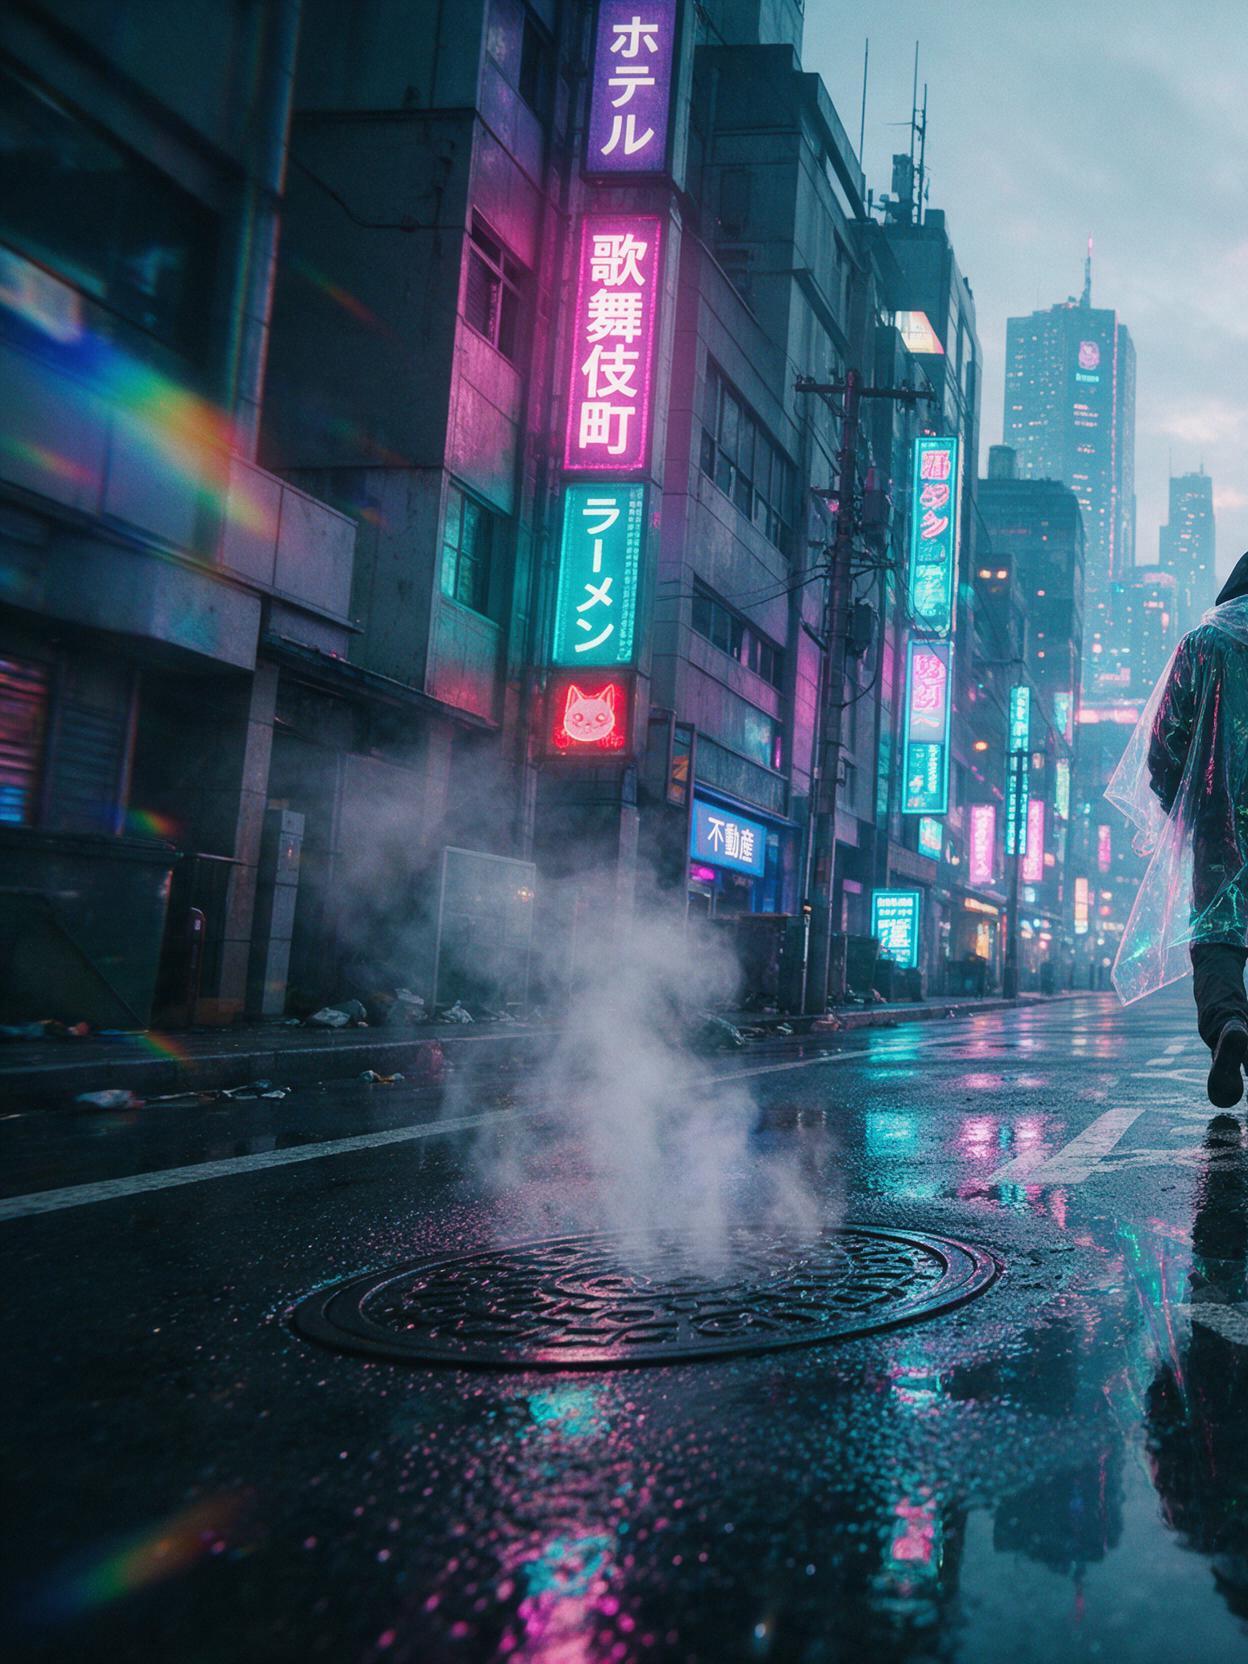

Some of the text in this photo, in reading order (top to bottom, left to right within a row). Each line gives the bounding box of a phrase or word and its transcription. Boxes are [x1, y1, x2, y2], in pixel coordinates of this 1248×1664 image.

[600, 16, 659, 156] ホテル
[578, 233, 648, 455] 歌舞伎町
[574, 498, 621, 653] ラーメン
